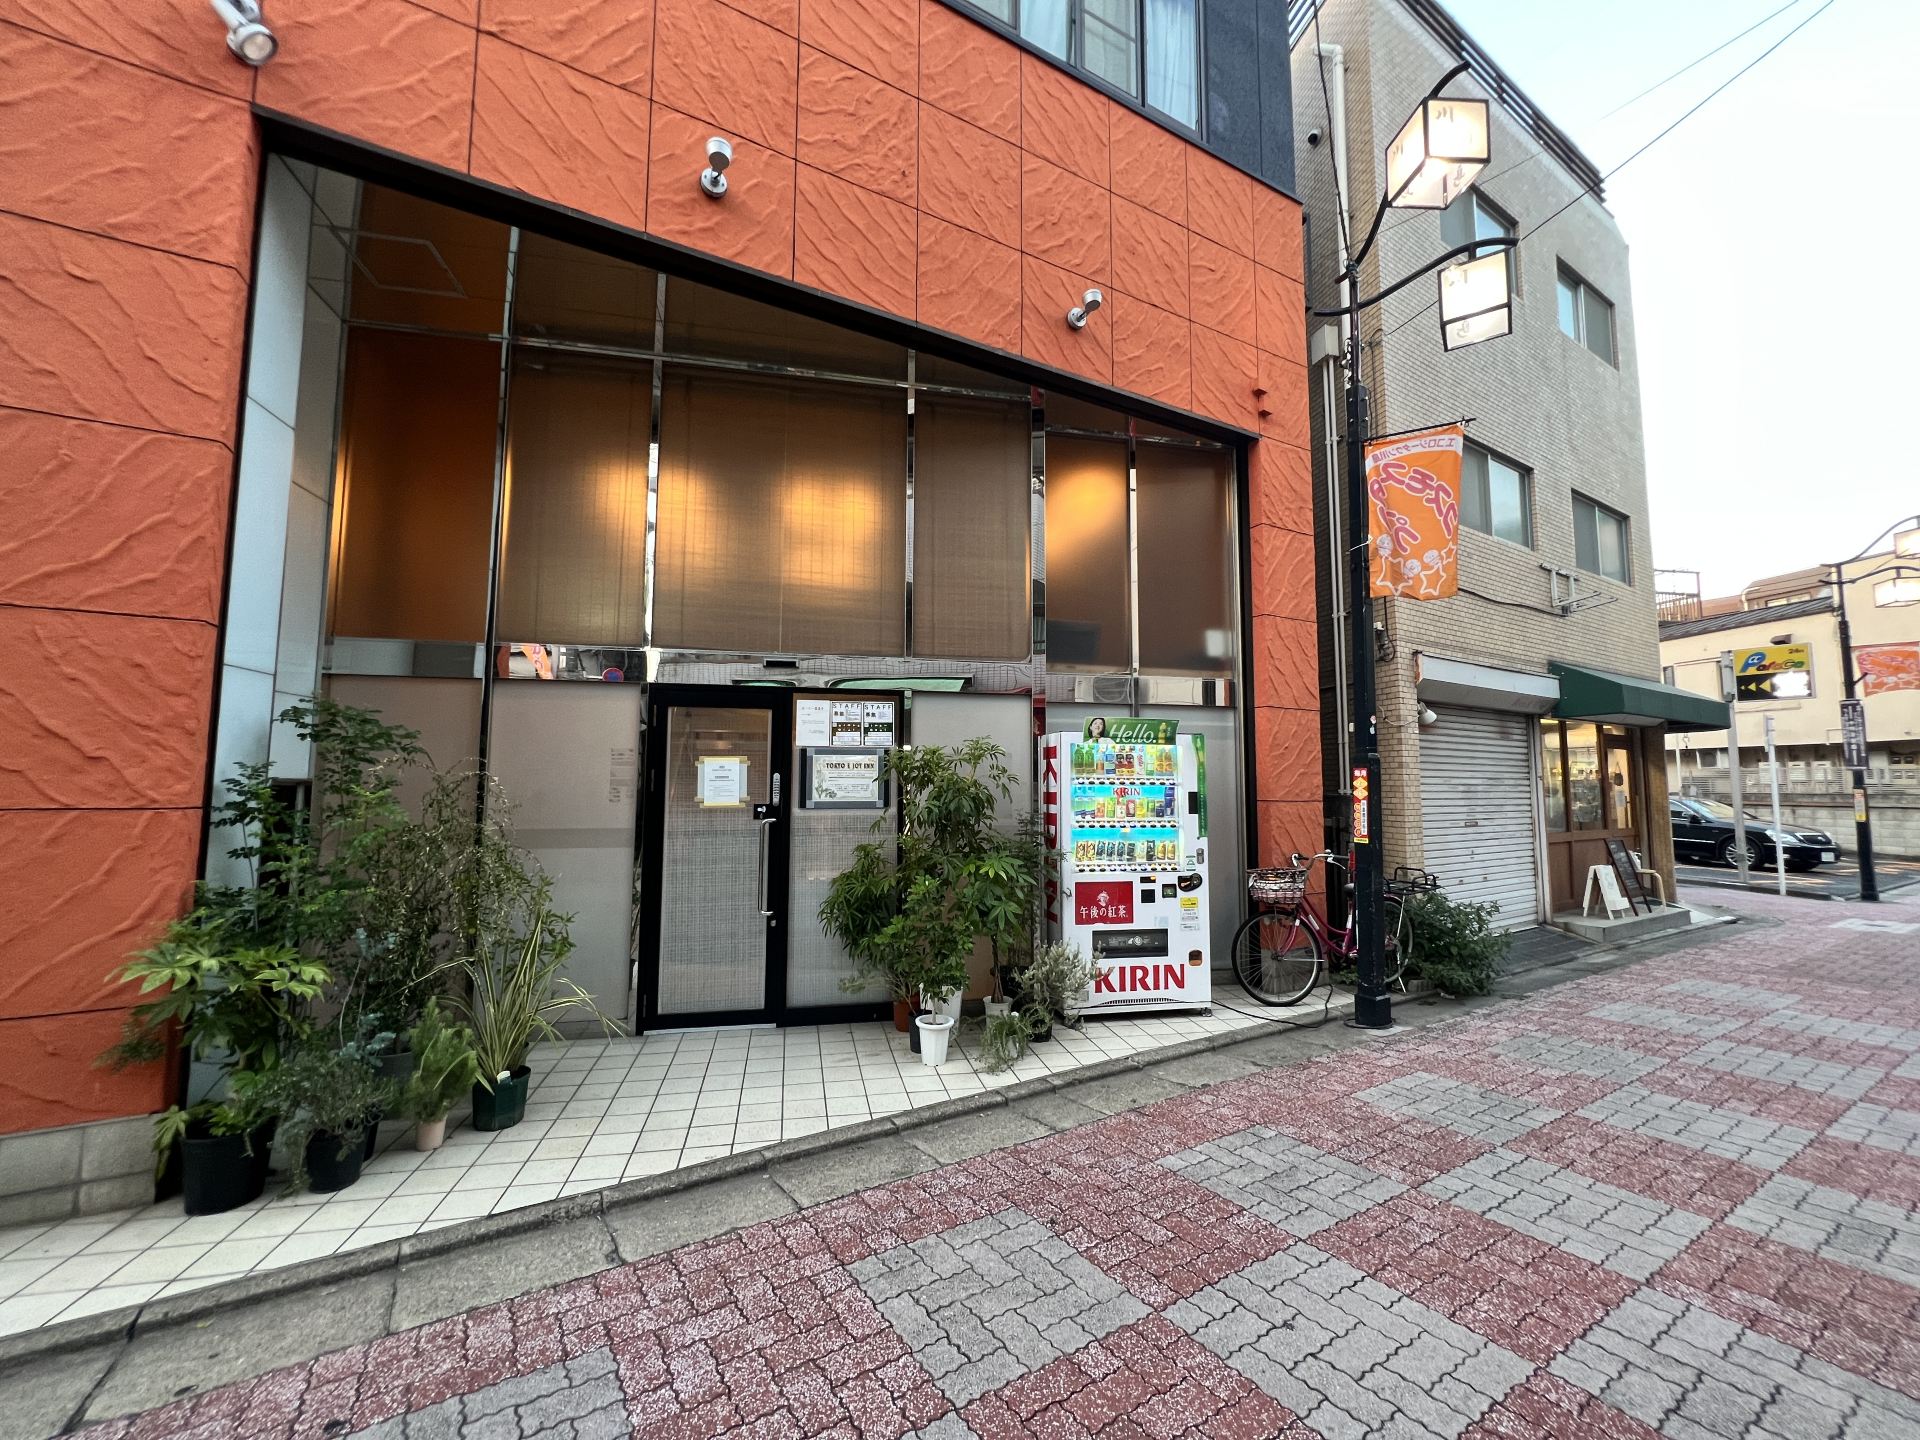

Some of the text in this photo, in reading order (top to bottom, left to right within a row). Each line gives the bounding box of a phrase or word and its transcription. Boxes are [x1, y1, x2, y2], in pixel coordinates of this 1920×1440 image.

[1109, 723, 1157, 744] Hello.
[1113, 787, 1141, 796] KIRIN
[1079, 904, 1127, 919] 午後の紅茶
[1094, 963, 1185, 993] KIRIN
